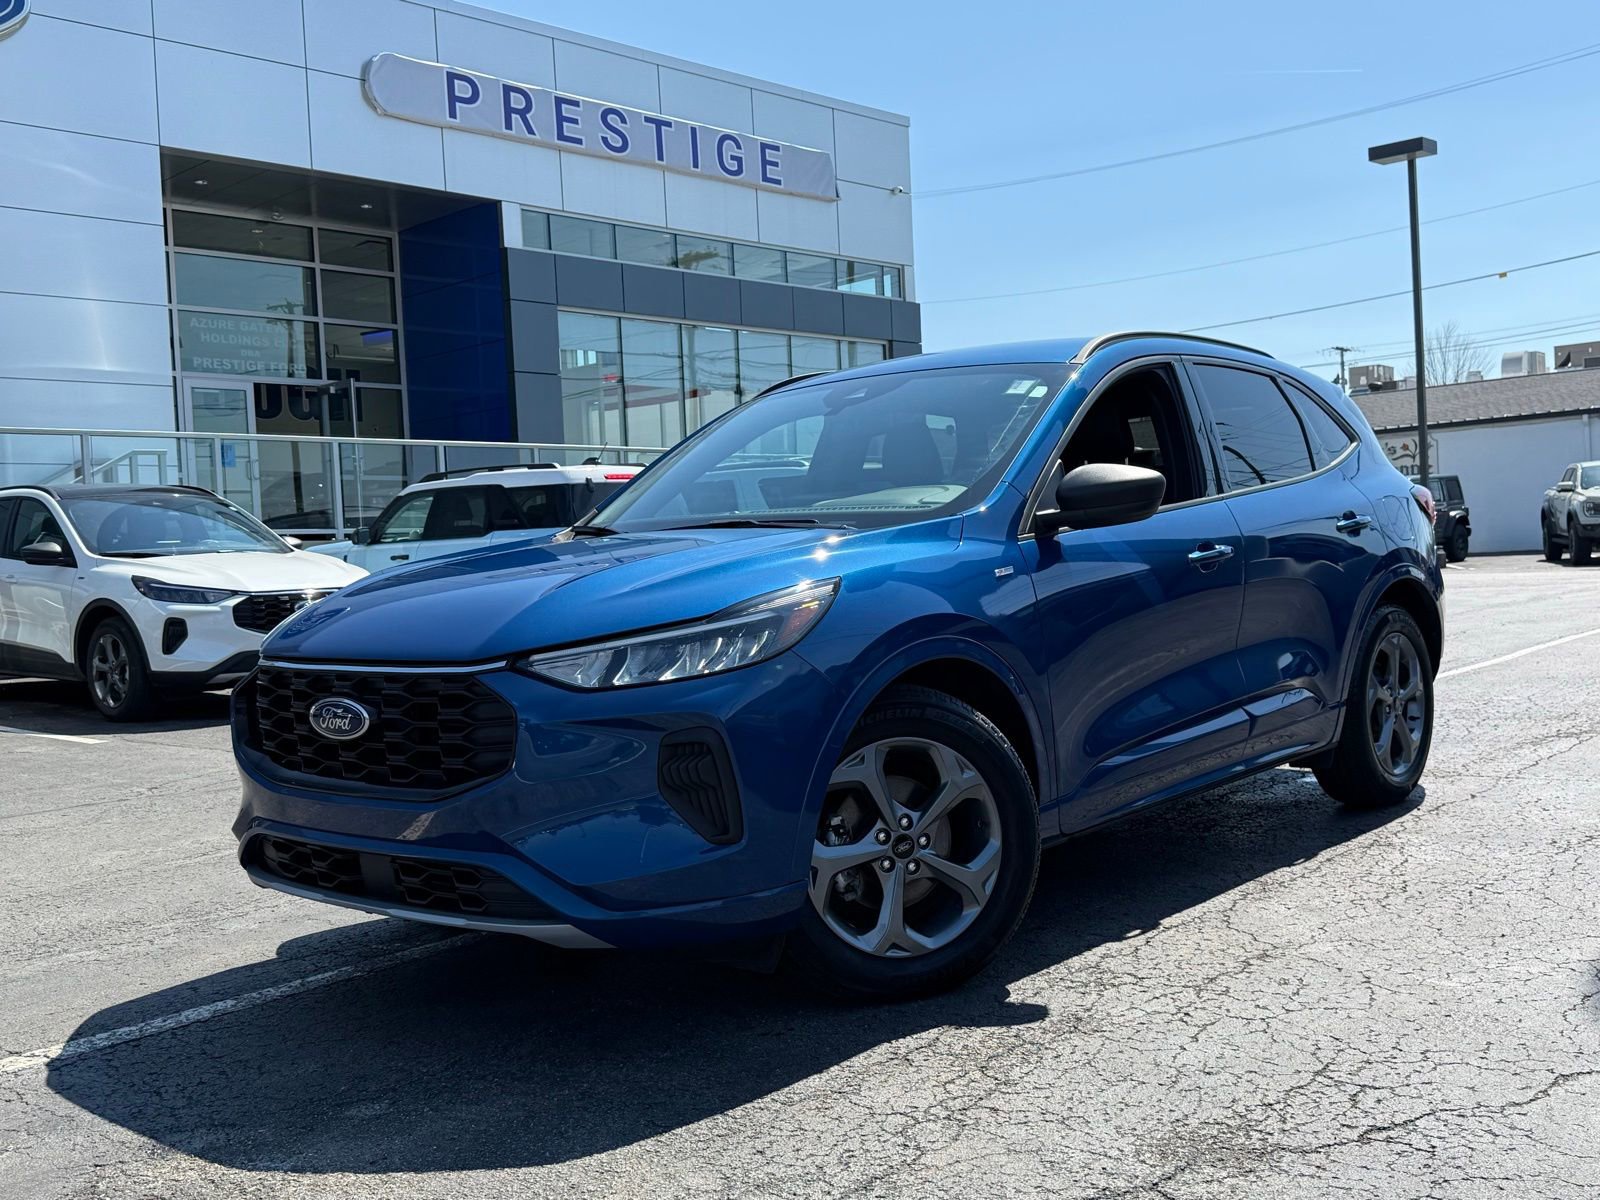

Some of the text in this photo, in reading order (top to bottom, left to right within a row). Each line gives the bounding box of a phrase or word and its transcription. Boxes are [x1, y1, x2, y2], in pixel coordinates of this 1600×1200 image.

[445, 70, 784, 187] PRESTIGE
[190, 317, 235, 330] AZURE
[200, 331, 269, 347] HOLDINGS
[193, 357, 265, 371] PRESTIGE
[320, 706, 360, 730] Ford
